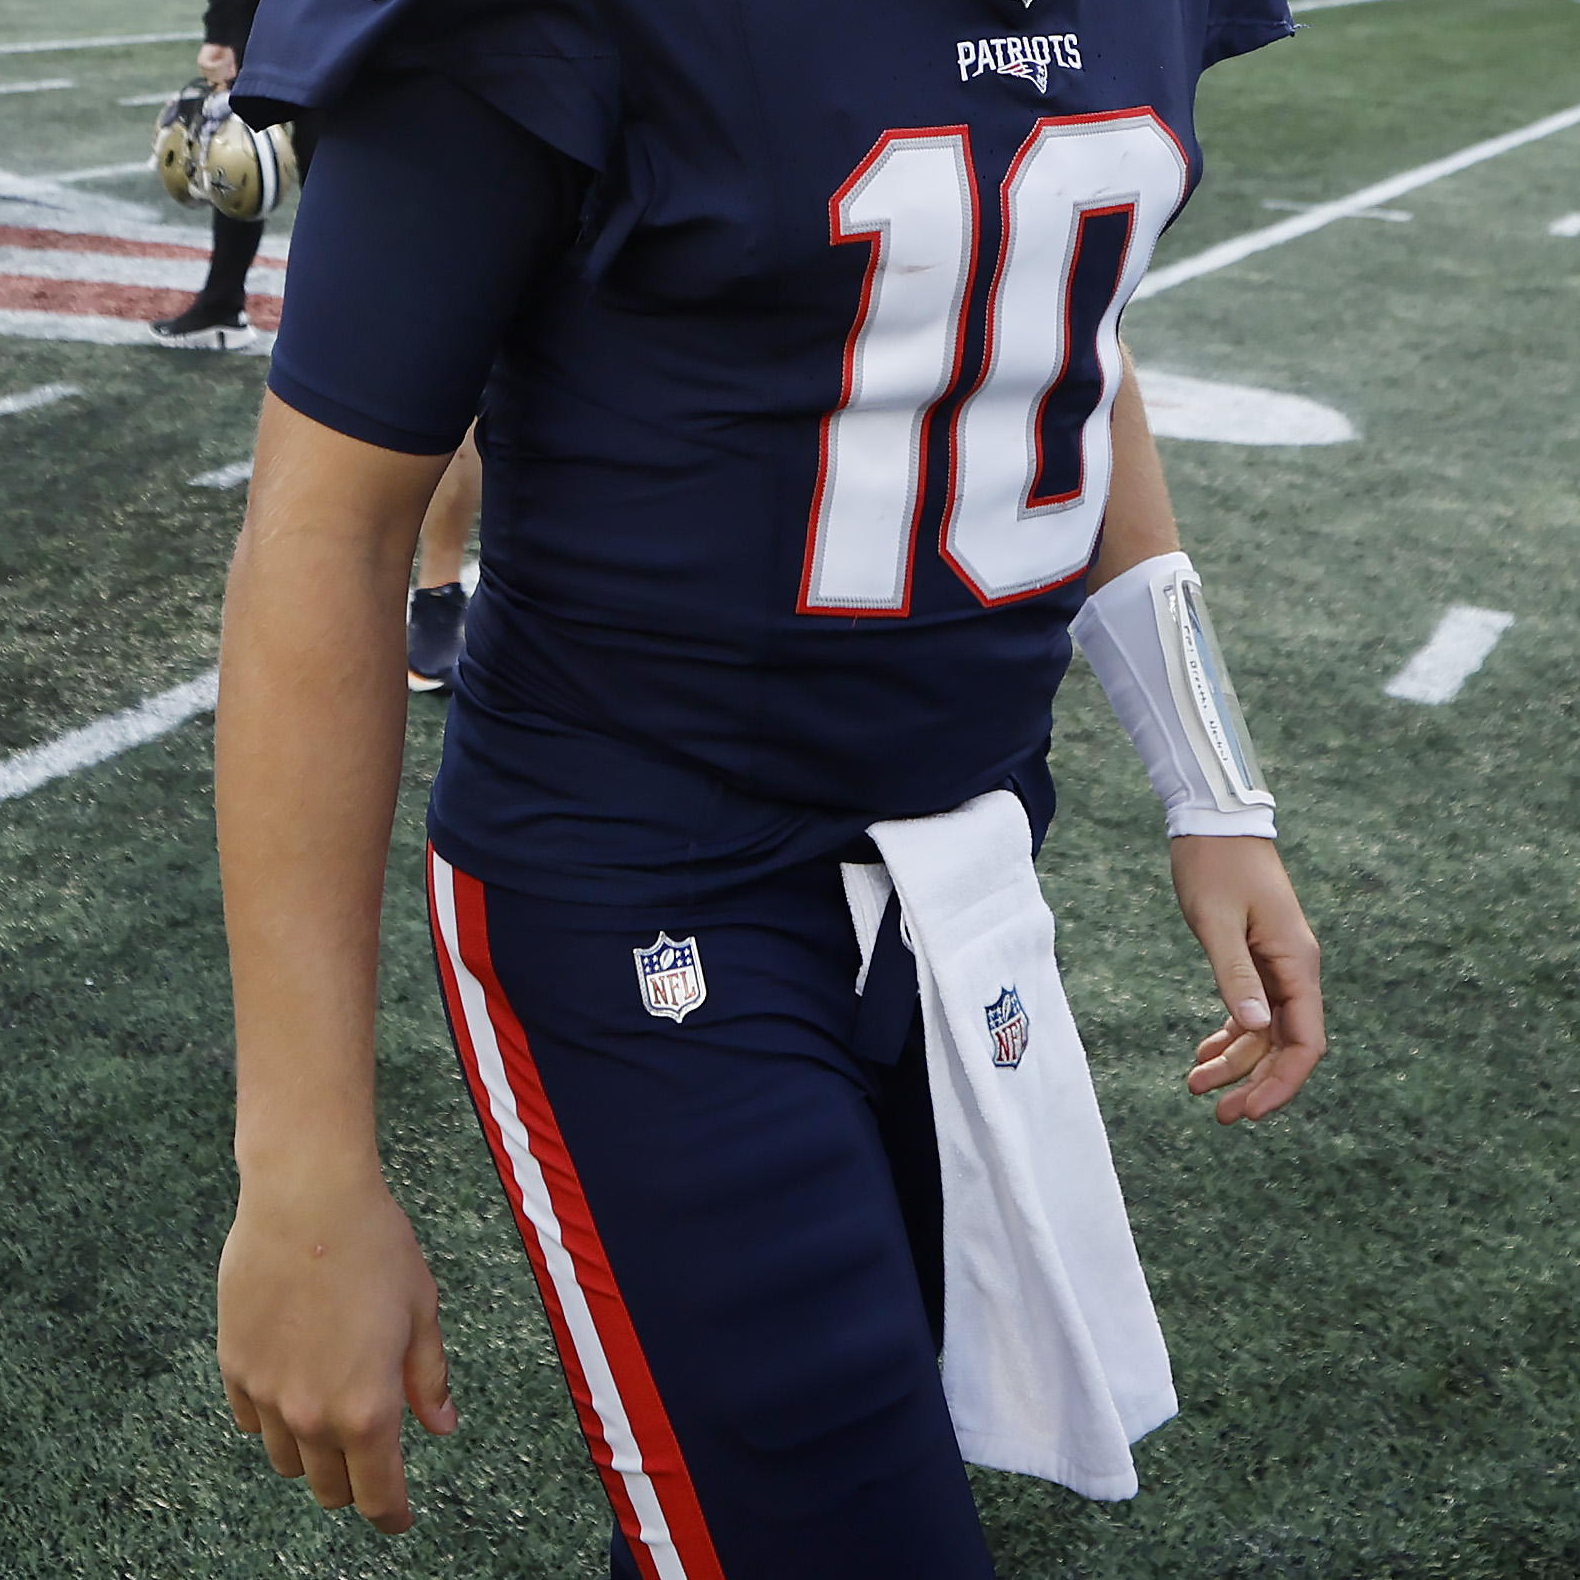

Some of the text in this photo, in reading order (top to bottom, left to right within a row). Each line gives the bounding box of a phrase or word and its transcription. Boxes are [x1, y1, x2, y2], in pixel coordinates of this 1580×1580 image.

[957, 34, 1083, 82] PATRIOTS
[795, 106, 1189, 618] 10
[651, 971, 696, 1008] NFL
[994, 1017, 1028, 1063] NFL
